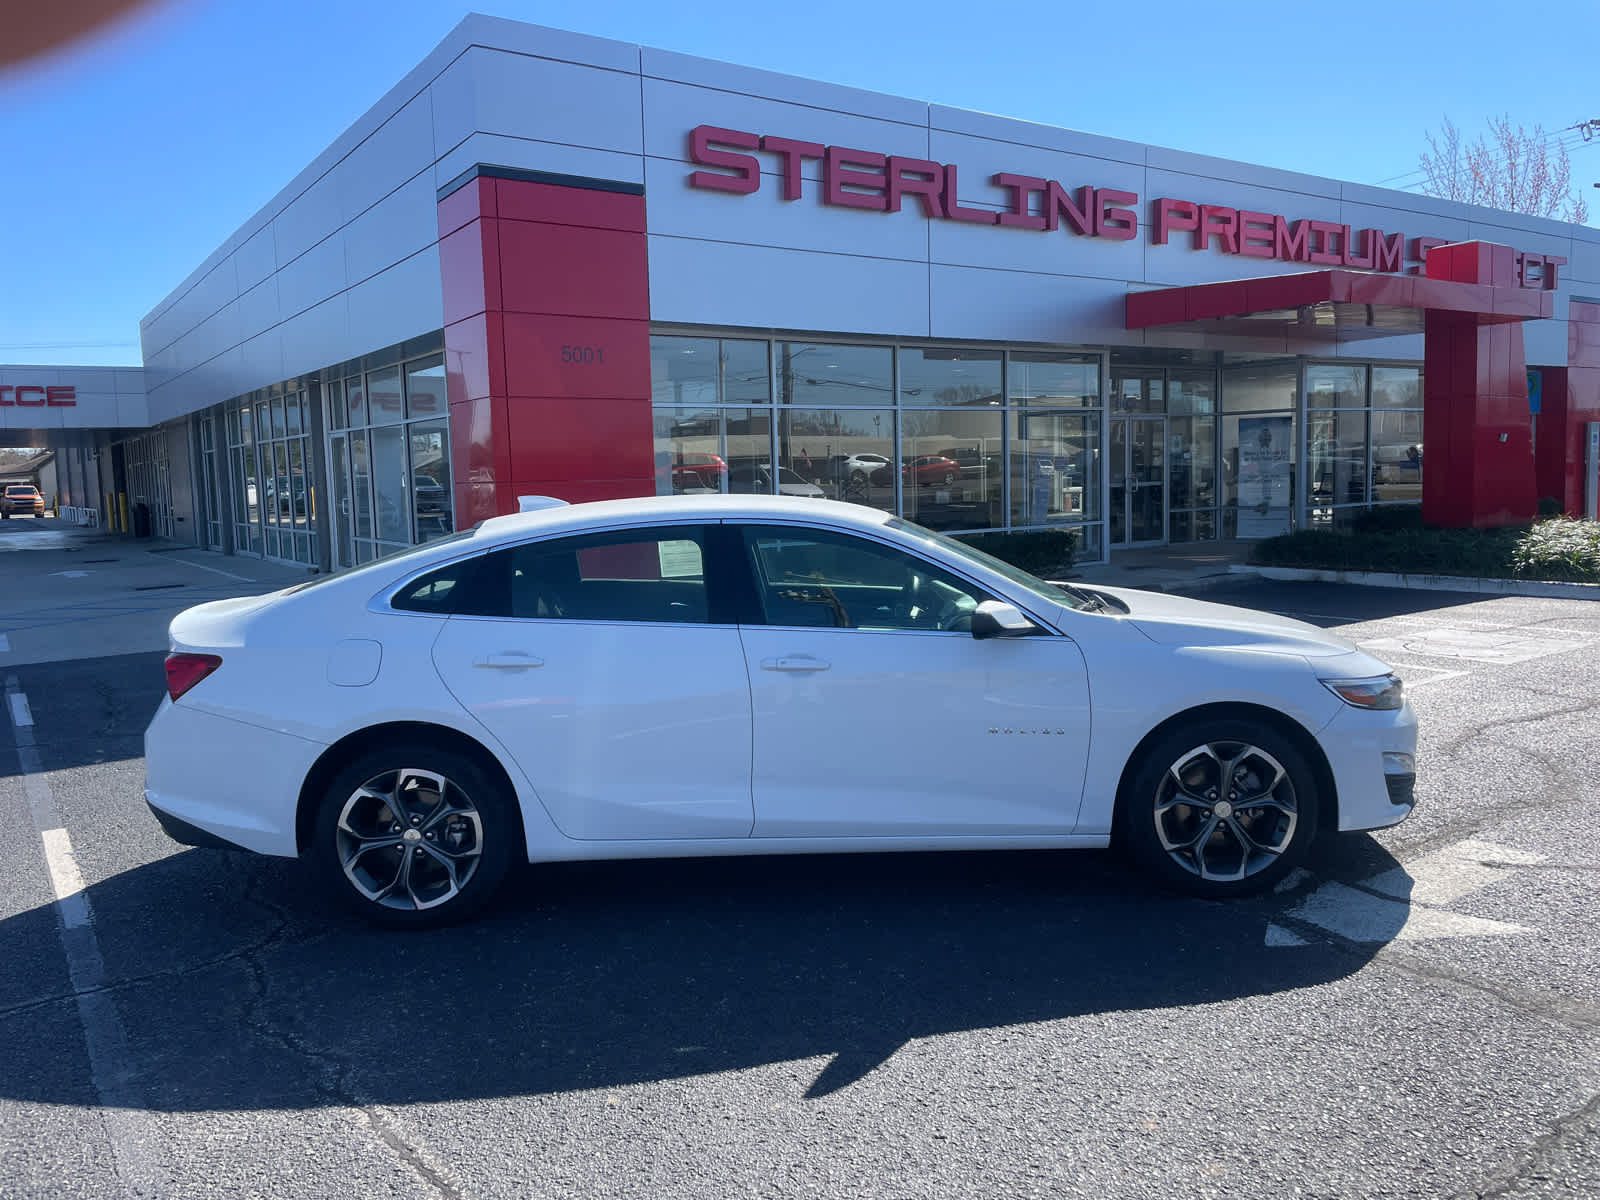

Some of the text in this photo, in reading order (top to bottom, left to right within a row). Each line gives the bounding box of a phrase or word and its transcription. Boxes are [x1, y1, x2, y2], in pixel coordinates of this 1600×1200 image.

[688, 124, 1137, 240] STERLING
[1152, 197, 1404, 273] PREMIUM
[561, 345, 603, 365] 5001
